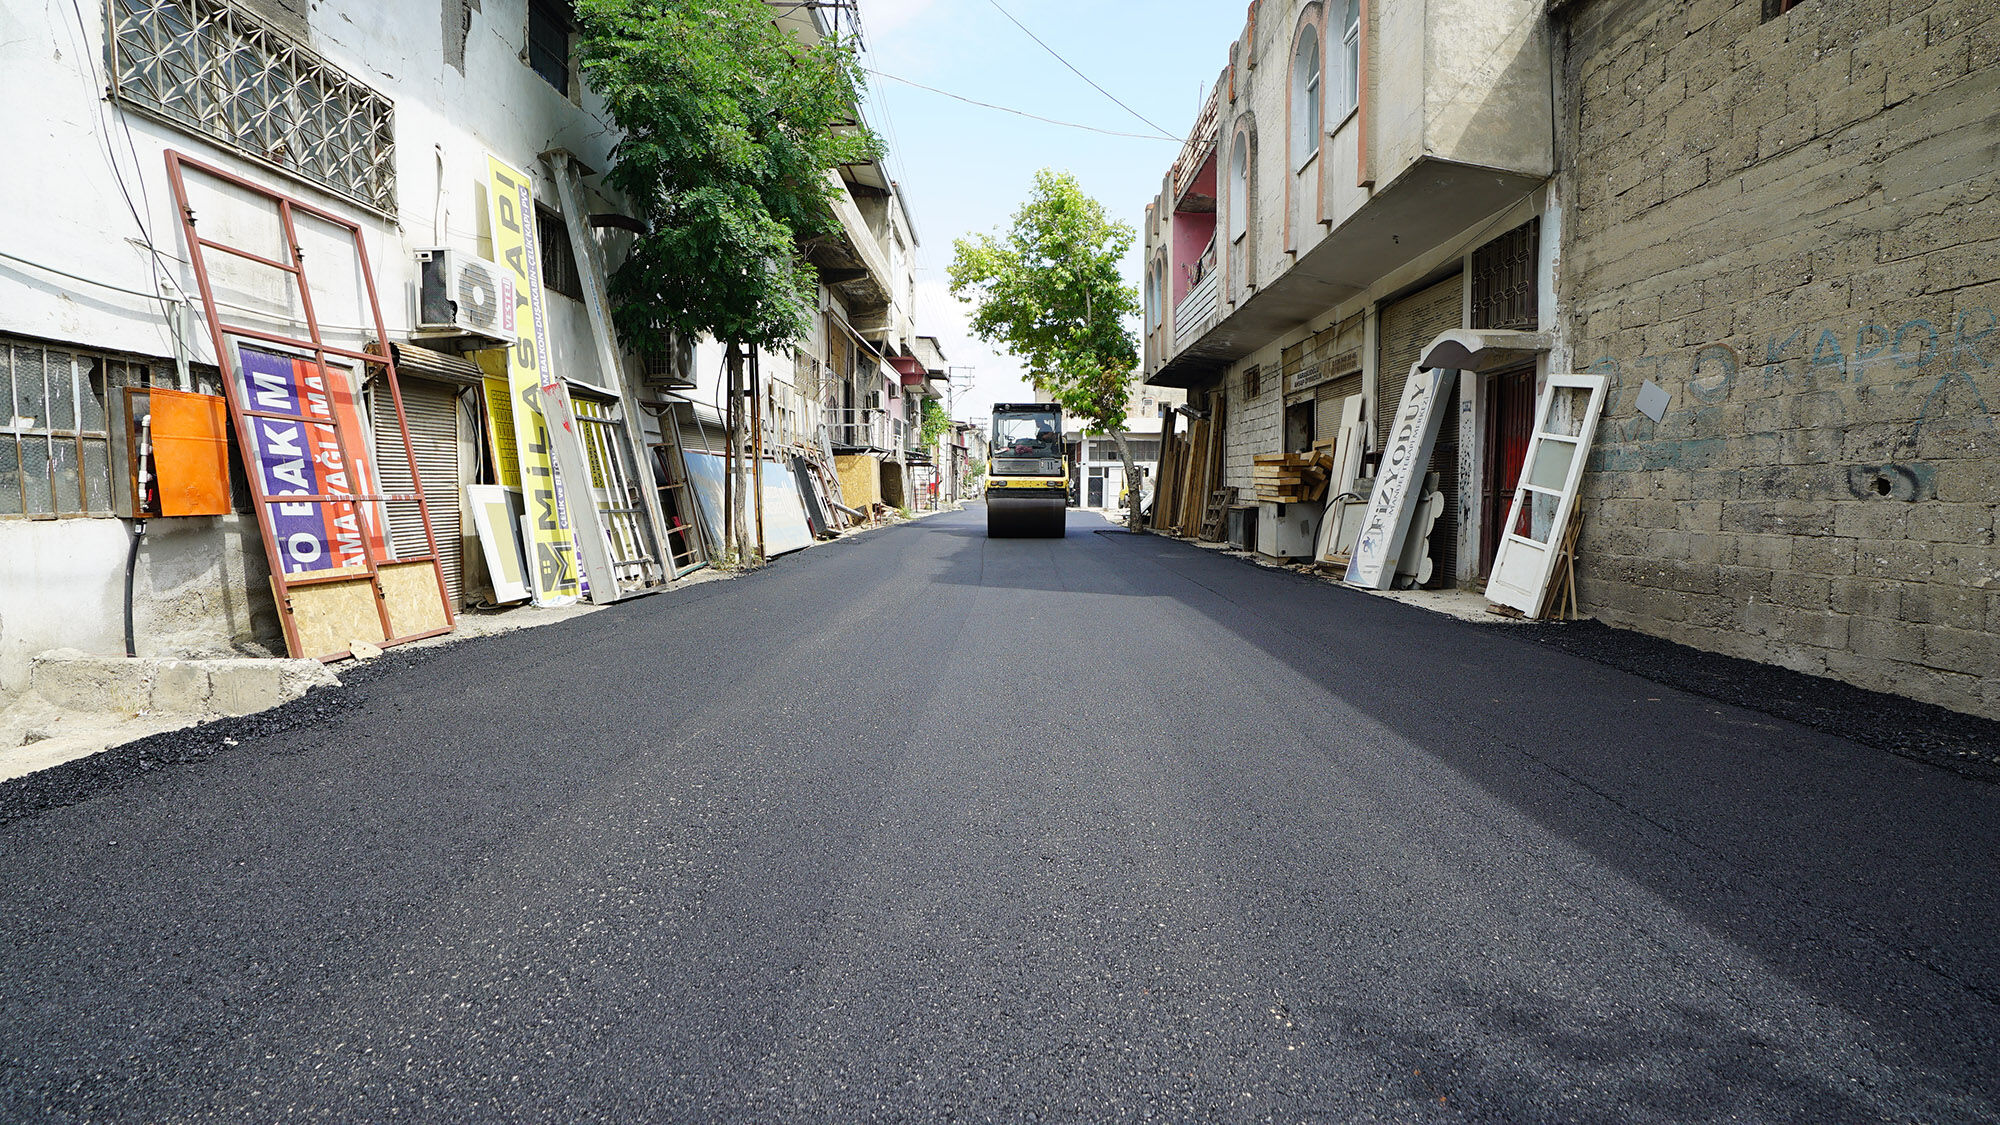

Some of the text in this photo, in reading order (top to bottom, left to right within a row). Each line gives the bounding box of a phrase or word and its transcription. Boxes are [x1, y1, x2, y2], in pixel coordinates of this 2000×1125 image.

[520, 187, 529, 206] PVC
[504, 279, 512, 329] VESTEL
[495, 171, 557, 530] MİLAS YAPI
[538, 330, 548, 371] BALKON
[252, 371, 314, 517] BAKIM
